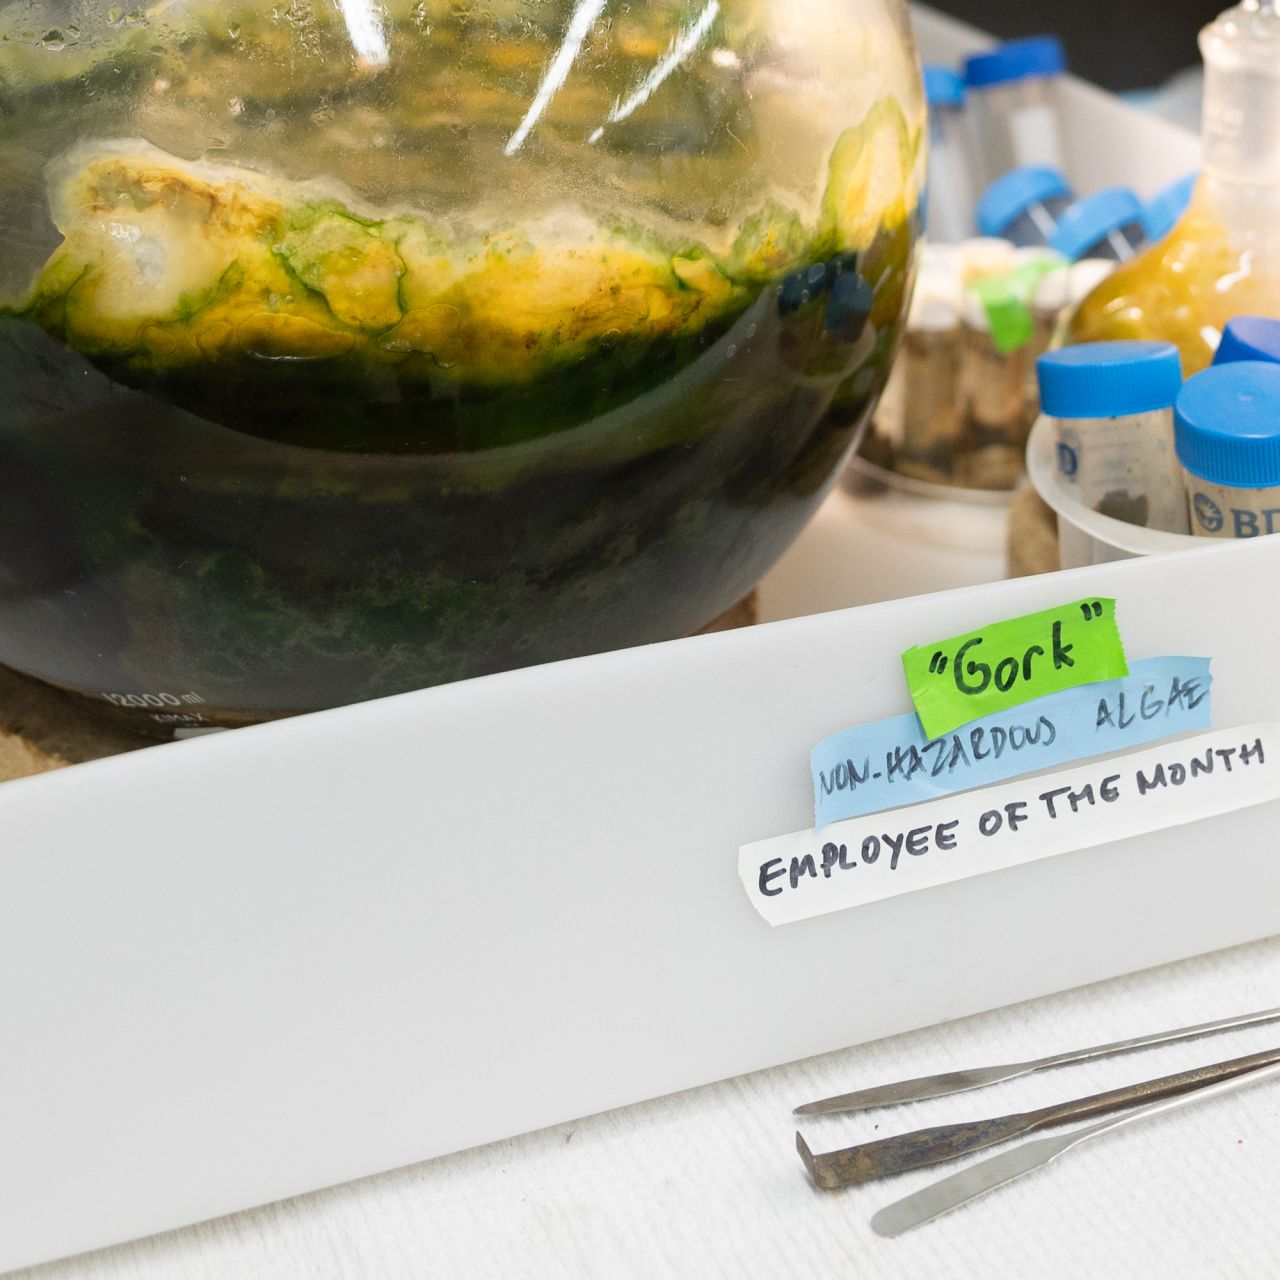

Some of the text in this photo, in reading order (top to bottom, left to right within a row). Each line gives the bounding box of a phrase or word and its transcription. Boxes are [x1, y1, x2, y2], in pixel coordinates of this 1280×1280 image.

[101, 691, 207, 707] 12000 ml
[928, 601, 1103, 696] "Gork"
[819, 676, 1210, 798] NON-HAZARDOUS ALGAE
[758, 737, 1265, 897] EMPLOYEE OF THE MONTH
